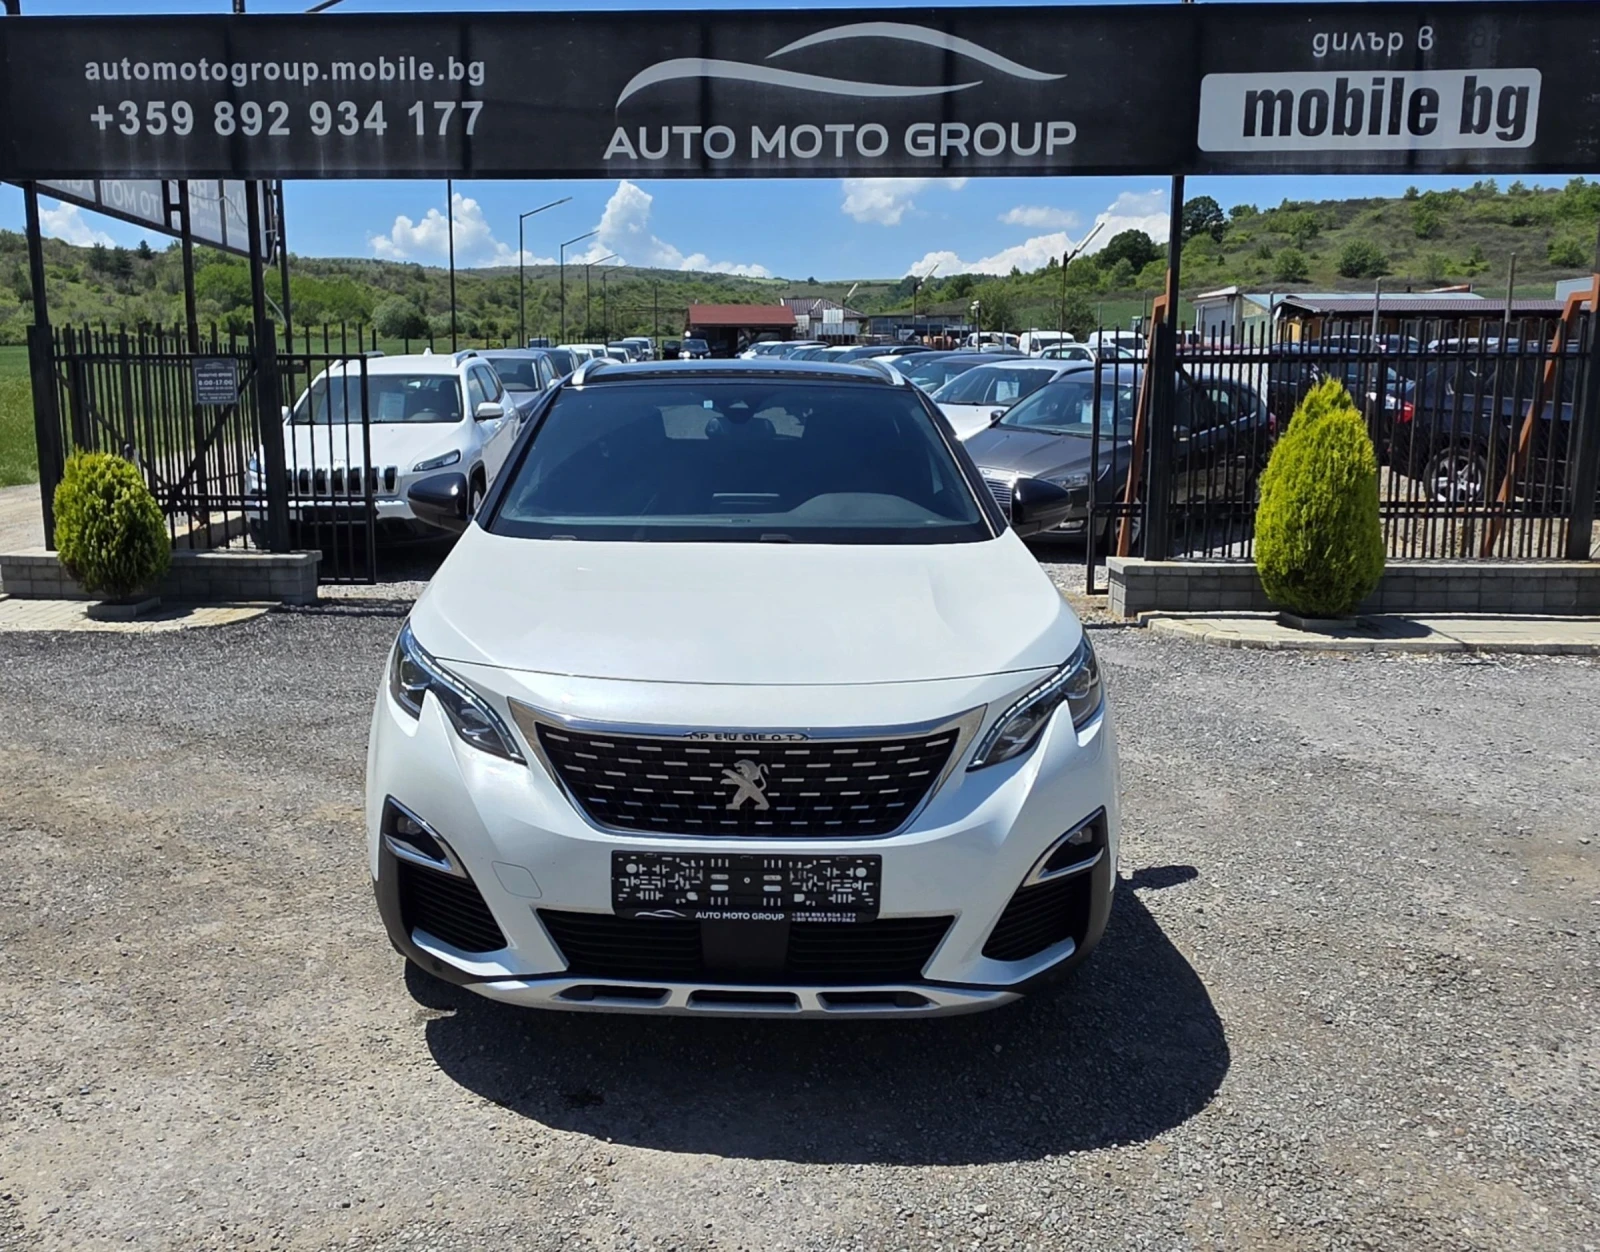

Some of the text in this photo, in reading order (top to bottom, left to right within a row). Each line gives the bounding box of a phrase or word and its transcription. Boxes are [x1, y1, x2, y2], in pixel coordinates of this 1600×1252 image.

[1312, 31, 1404, 58] дилър
[85, 57, 486, 88] automotogroup.mobile.bg
[90, 101, 485, 137] +359 892 934 177
[1243, 76, 1530, 141] mobile bg
[603, 120, 1077, 160] AUTO MOTO GROUP
[695, 911, 785, 922] AUTO MOTO GROUP
